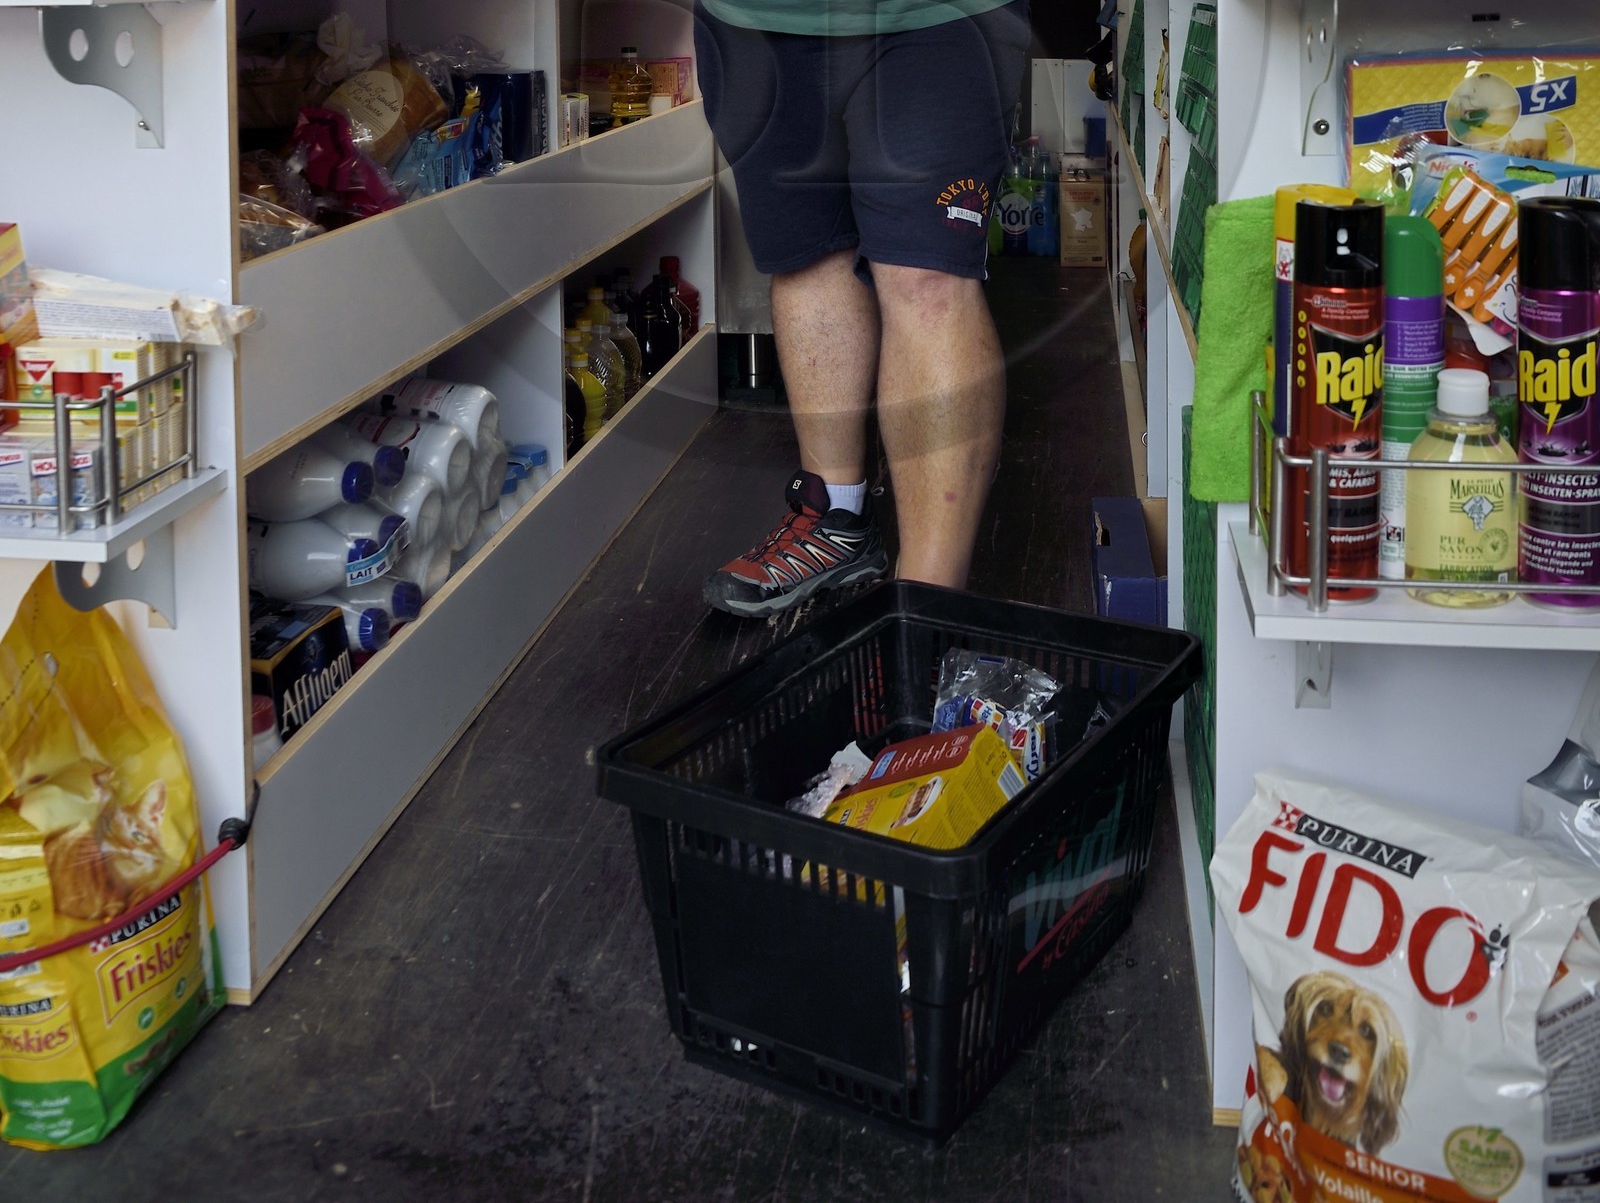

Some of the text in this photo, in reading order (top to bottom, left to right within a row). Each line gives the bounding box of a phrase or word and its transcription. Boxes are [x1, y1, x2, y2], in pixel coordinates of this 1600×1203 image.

[936, 177, 976, 207] TOKYO
[1519, 340, 1597, 403] Raid
[1338, 476, 1376, 489] CAFARDS
[1450, 477, 1505, 500] MARSEILLAIS
[1440, 535, 1466, 544] PUR
[1440, 545, 1483, 554] SAVON
[1552, 549, 1592, 561] rampants
[350, 567, 372, 580] LAIT
[1299, 817, 1414, 877] PURINA
[1023, 795, 1125, 953] vival
[110, 895, 183, 944] PURINA
[1238, 829, 1491, 1008] FIDO
[107, 930, 193, 1004] Friskies
[1458, 1138, 1512, 1161] SANS
[1344, 1150, 1427, 1193] SENIOR
